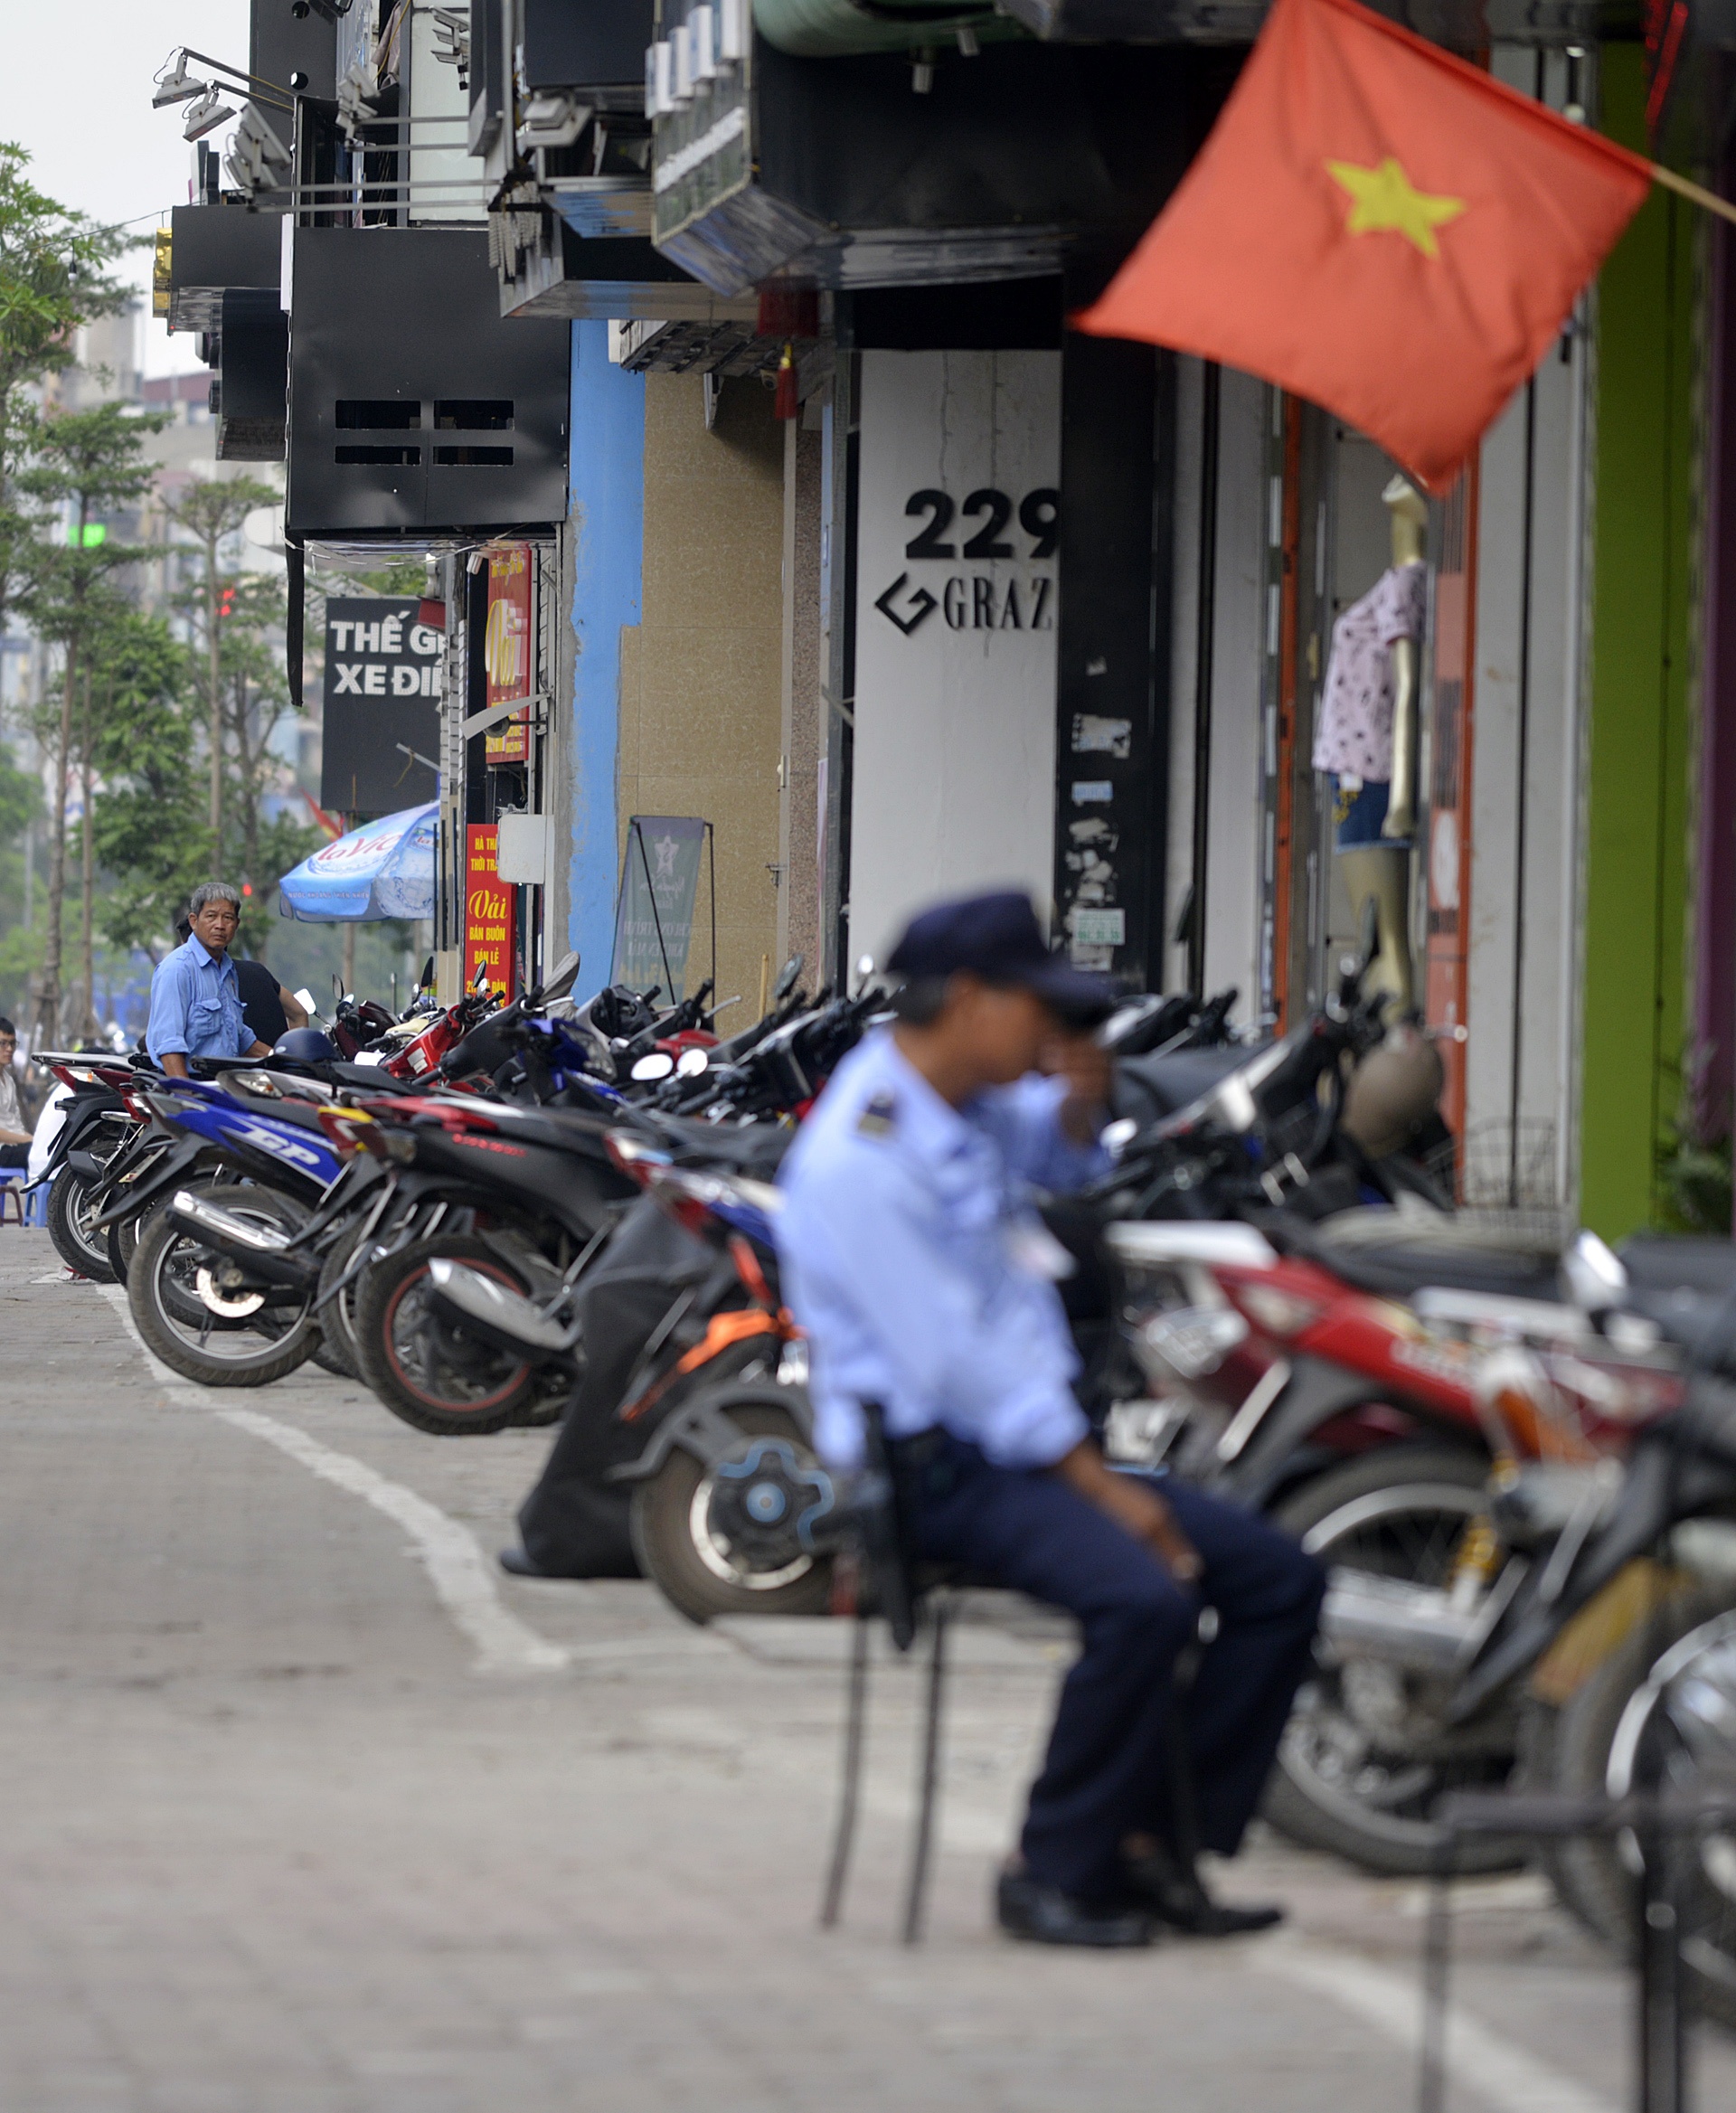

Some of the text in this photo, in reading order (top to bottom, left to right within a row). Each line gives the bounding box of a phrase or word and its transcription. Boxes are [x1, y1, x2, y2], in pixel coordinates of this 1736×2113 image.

[904, 488, 1061, 560] 229
[942, 576, 1052, 631] GRAZ
[330, 610, 411, 654] THẾ
[333, 663, 387, 695] XE
[475, 835, 484, 850] HÀ
[470, 857, 485, 871] THỜI
[468, 890, 507, 920] Vải
[469, 924, 505, 940] BÁN BUÔN
[474, 948, 499, 965] BÁN LẺ
